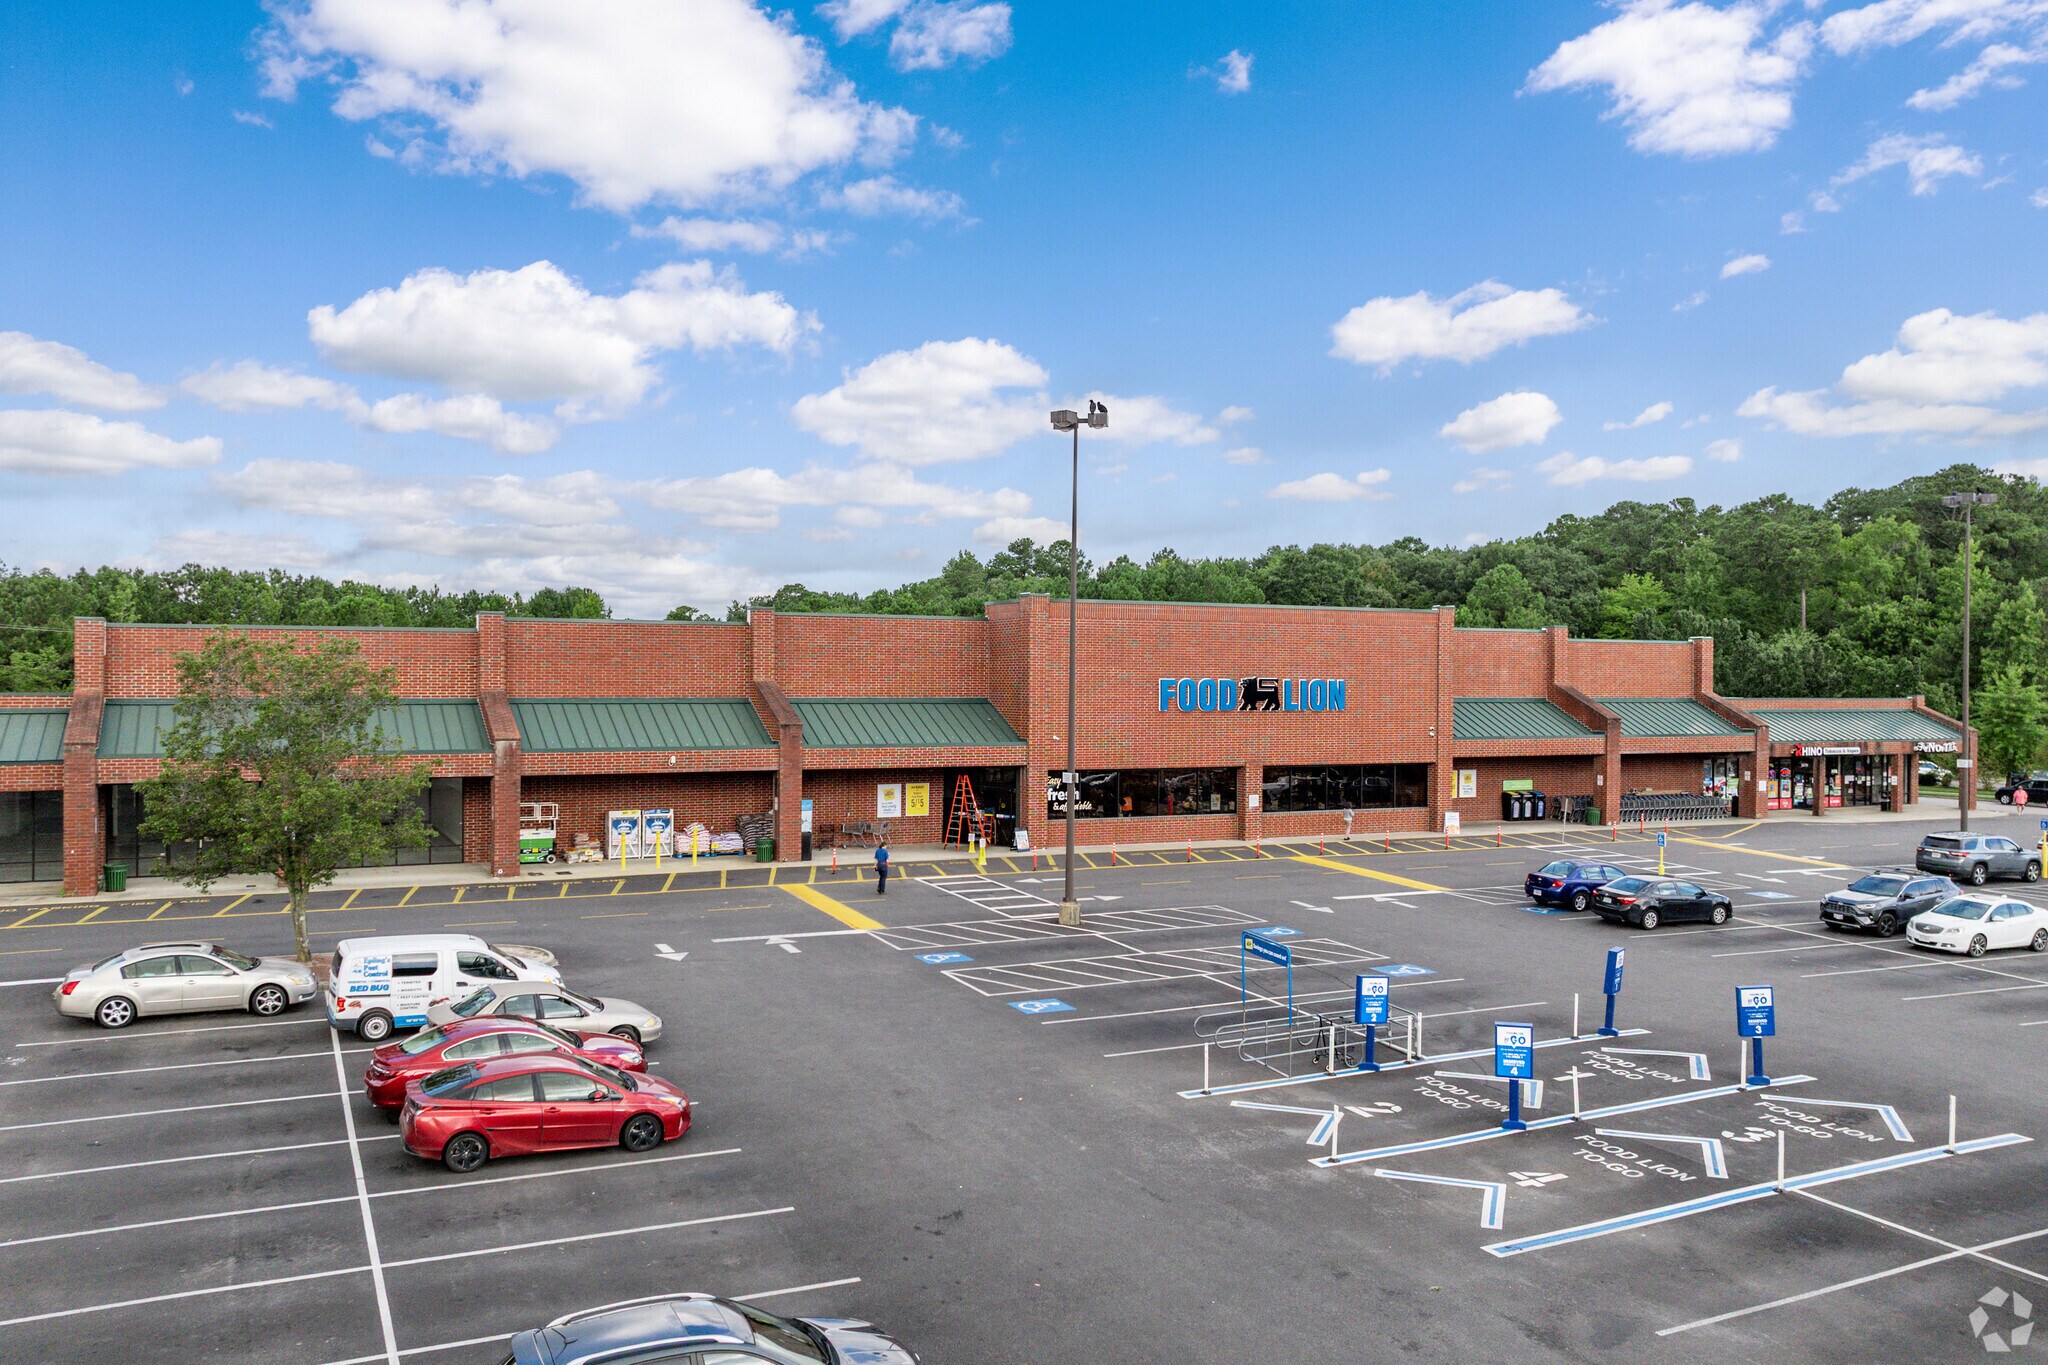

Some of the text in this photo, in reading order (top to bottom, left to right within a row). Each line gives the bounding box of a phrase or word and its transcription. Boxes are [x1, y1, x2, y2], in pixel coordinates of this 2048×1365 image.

[1158, 677, 1347, 711] FOOD LION
[1794, 744, 1823, 757] RHINO
[363, 970, 388, 978] Control
[349, 984, 390, 993] BED BUG
[1753, 996, 1768, 1005] GO
[1371, 1013, 1378, 1022] 2
[1755, 1025, 1763, 1034] 3
[1510, 1035, 1527, 1045] GO
[1510, 1066, 1519, 1076] 4
[1581, 1050, 1687, 1083] FOOD LION
[1583, 1059, 1644, 1080] TO-GO
[1415, 1075, 1469, 1096] FOOD
[1413, 1086, 1472, 1109] TO-GO
[1753, 1101, 1886, 1142] FOOD LION
[1758, 1113, 1833, 1139] TO-GO
[1572, 1148, 1645, 1178] TO-GO
[1573, 1134, 1697, 1182] FOOD LION
[1507, 1171, 1569, 1187] 4
